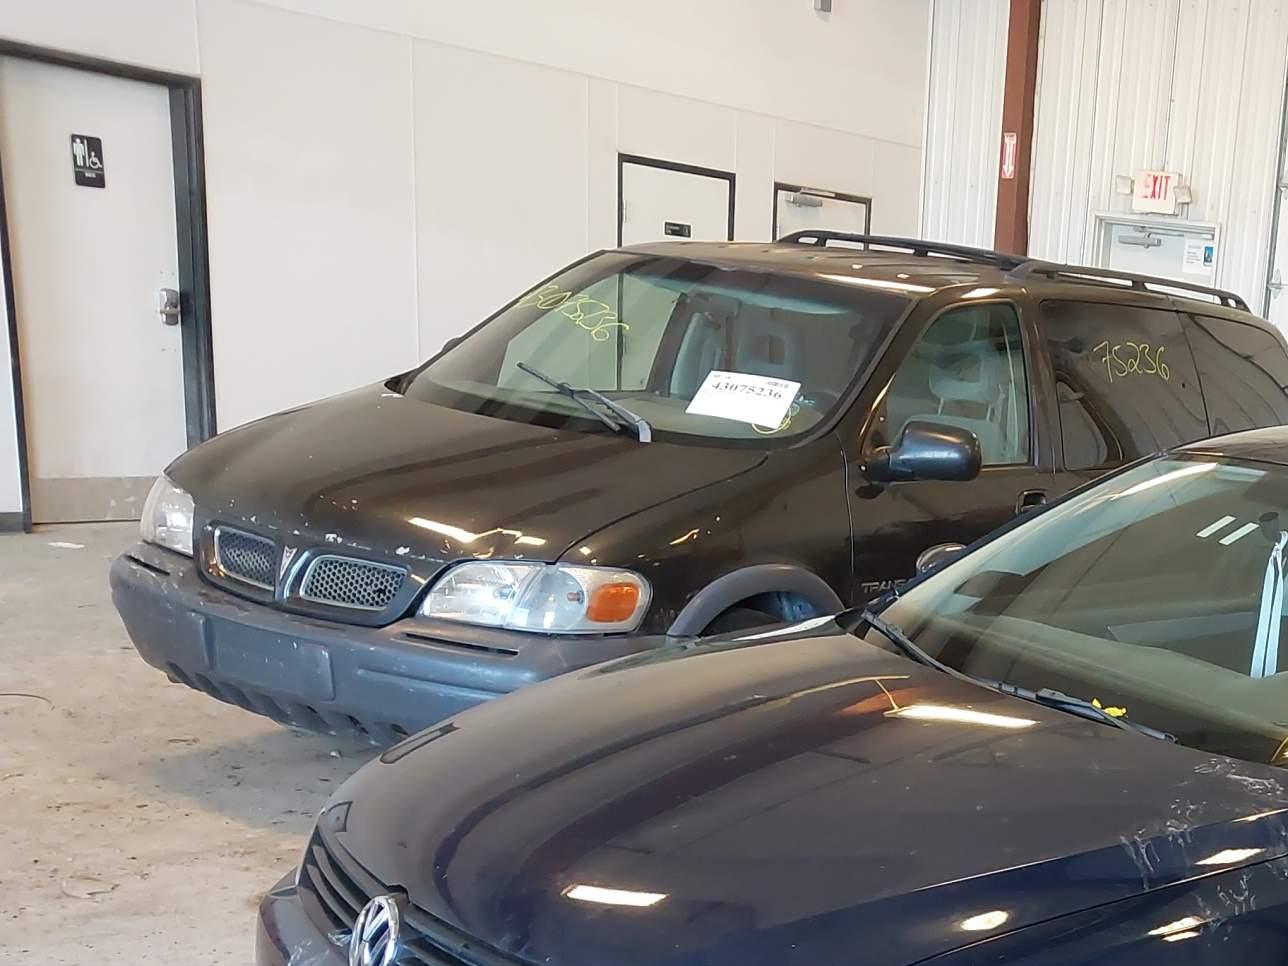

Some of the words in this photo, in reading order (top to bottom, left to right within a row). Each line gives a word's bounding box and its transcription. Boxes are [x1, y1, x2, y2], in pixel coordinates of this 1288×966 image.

[1142, 173, 1171, 200] EXIT
[1093, 340, 1170, 383] 75236
[711, 381, 782, 400] 43075236
